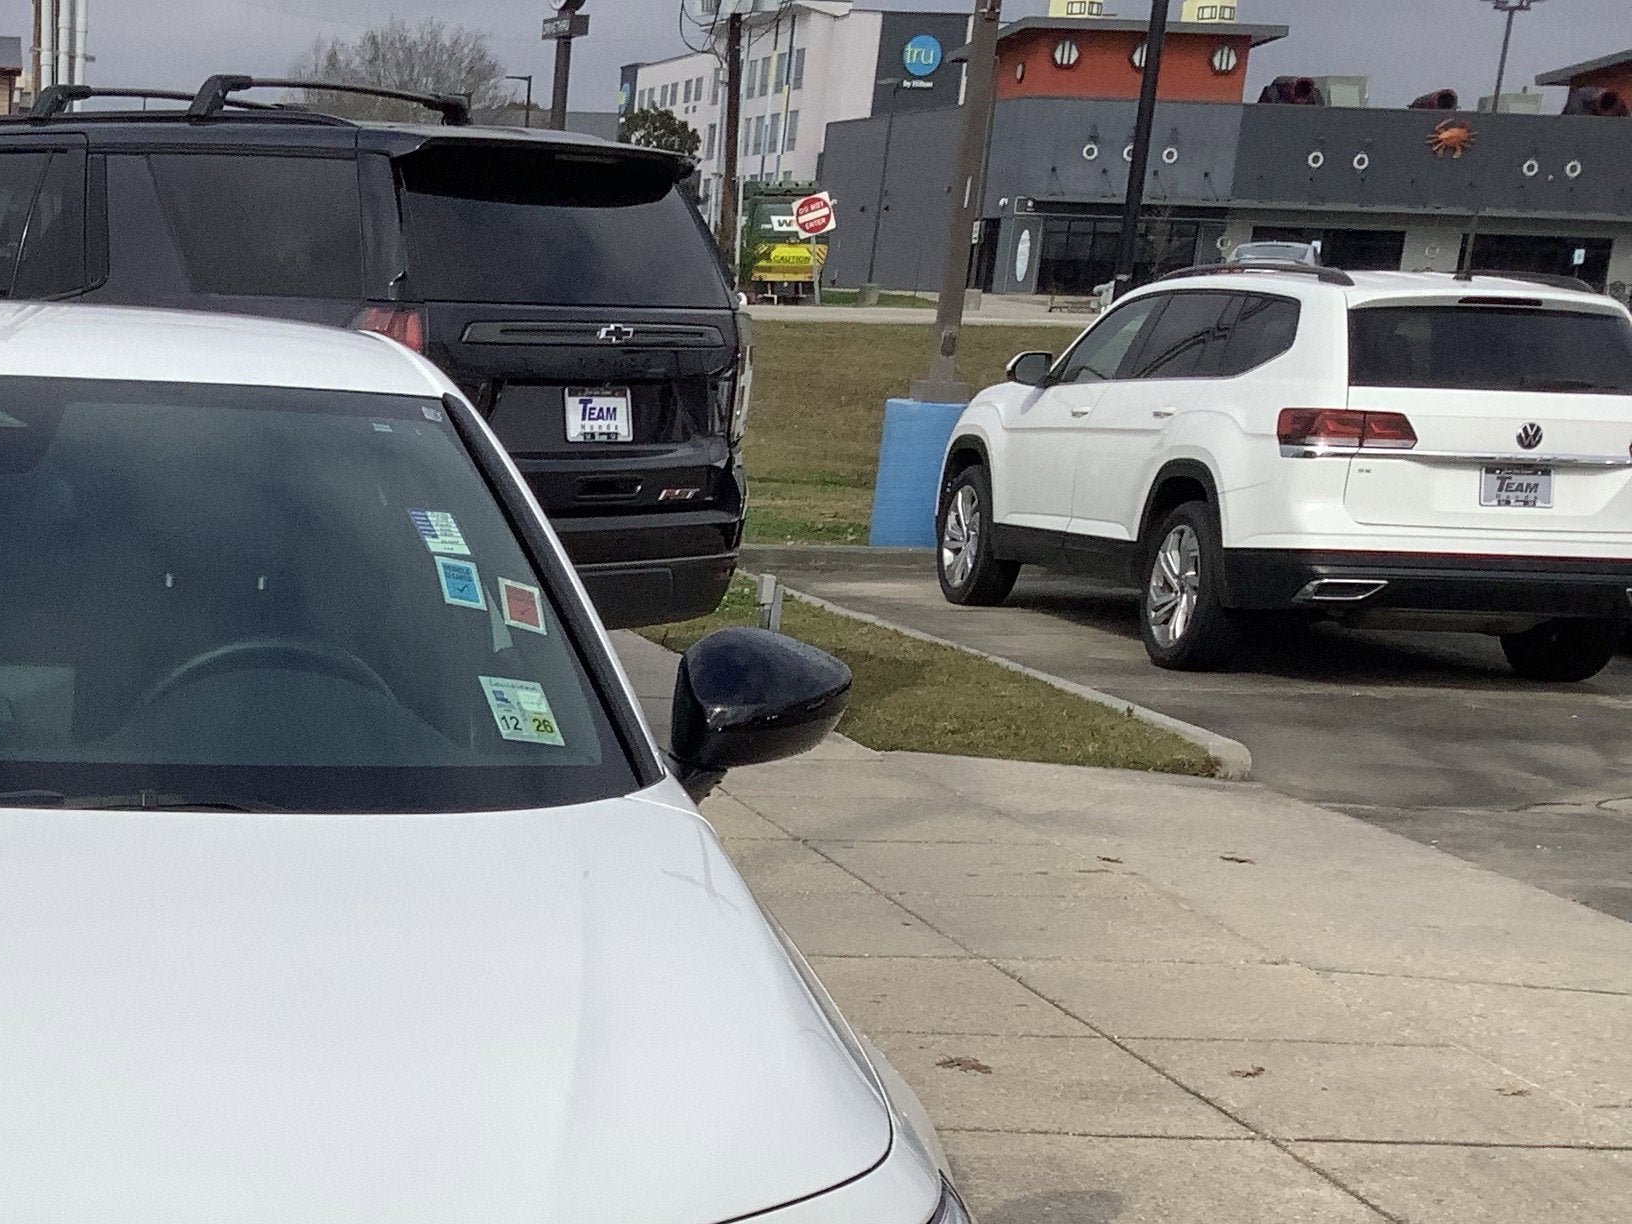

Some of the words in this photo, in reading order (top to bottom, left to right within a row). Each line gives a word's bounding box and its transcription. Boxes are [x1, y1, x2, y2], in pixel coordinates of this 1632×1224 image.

[904, 42, 934, 65] tru
[798, 205, 809, 215] DO
[810, 201, 825, 211] NOT
[804, 217, 826, 231] ENTER
[772, 255, 811, 265] CAUTION
[579, 398, 618, 421] TEAM
[1496, 475, 1539, 494] TEAM
[501, 715, 523, 731] 12
[532, 717, 555, 734] 26
